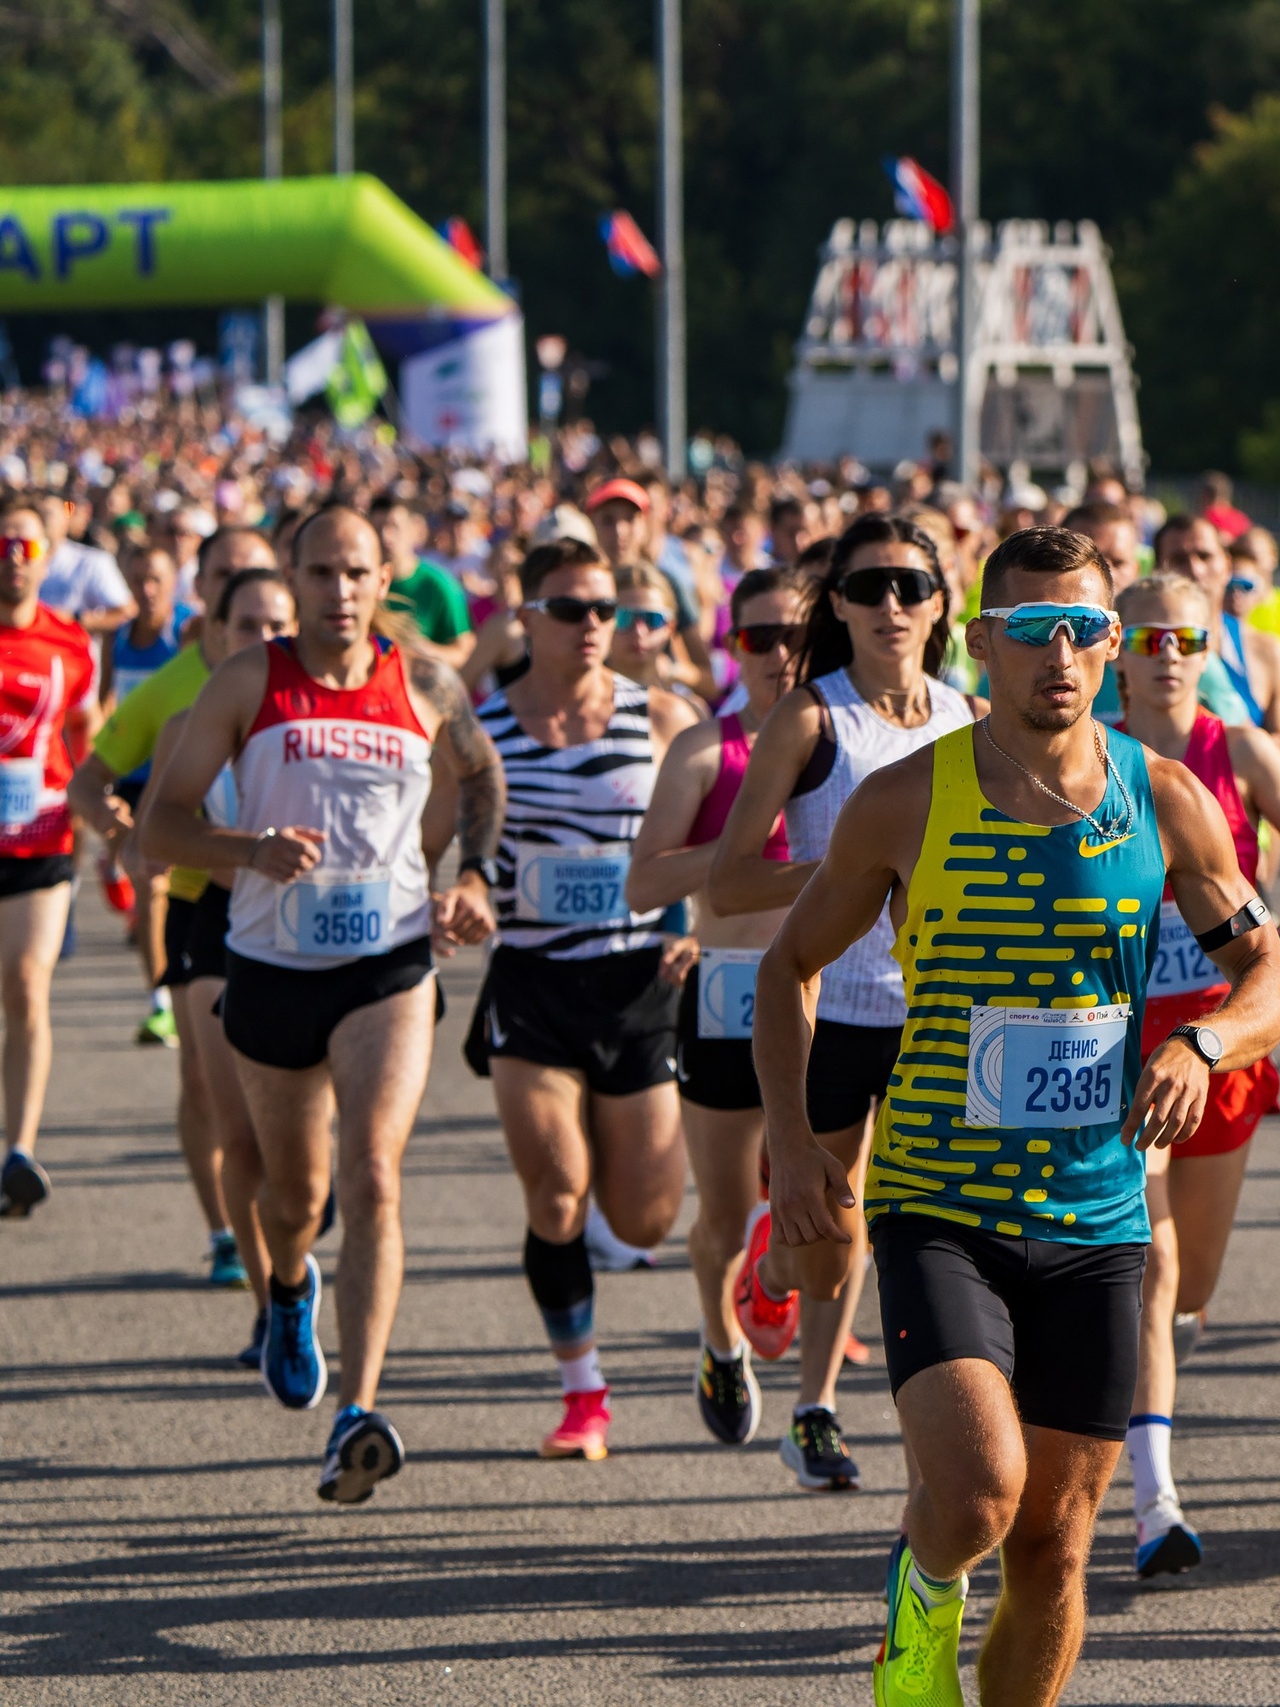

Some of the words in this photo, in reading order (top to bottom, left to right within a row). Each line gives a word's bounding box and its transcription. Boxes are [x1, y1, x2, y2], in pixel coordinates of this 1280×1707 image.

[284, 725, 404, 770] RUSSIA
[555, 882, 619, 913] 2637
[314, 910, 380, 945] 3590
[1096, 1011, 1108, 1020] Пэй
[1048, 1038, 1098, 1061] ДЕНИС
[1025, 1063, 1111, 1113] 2335
